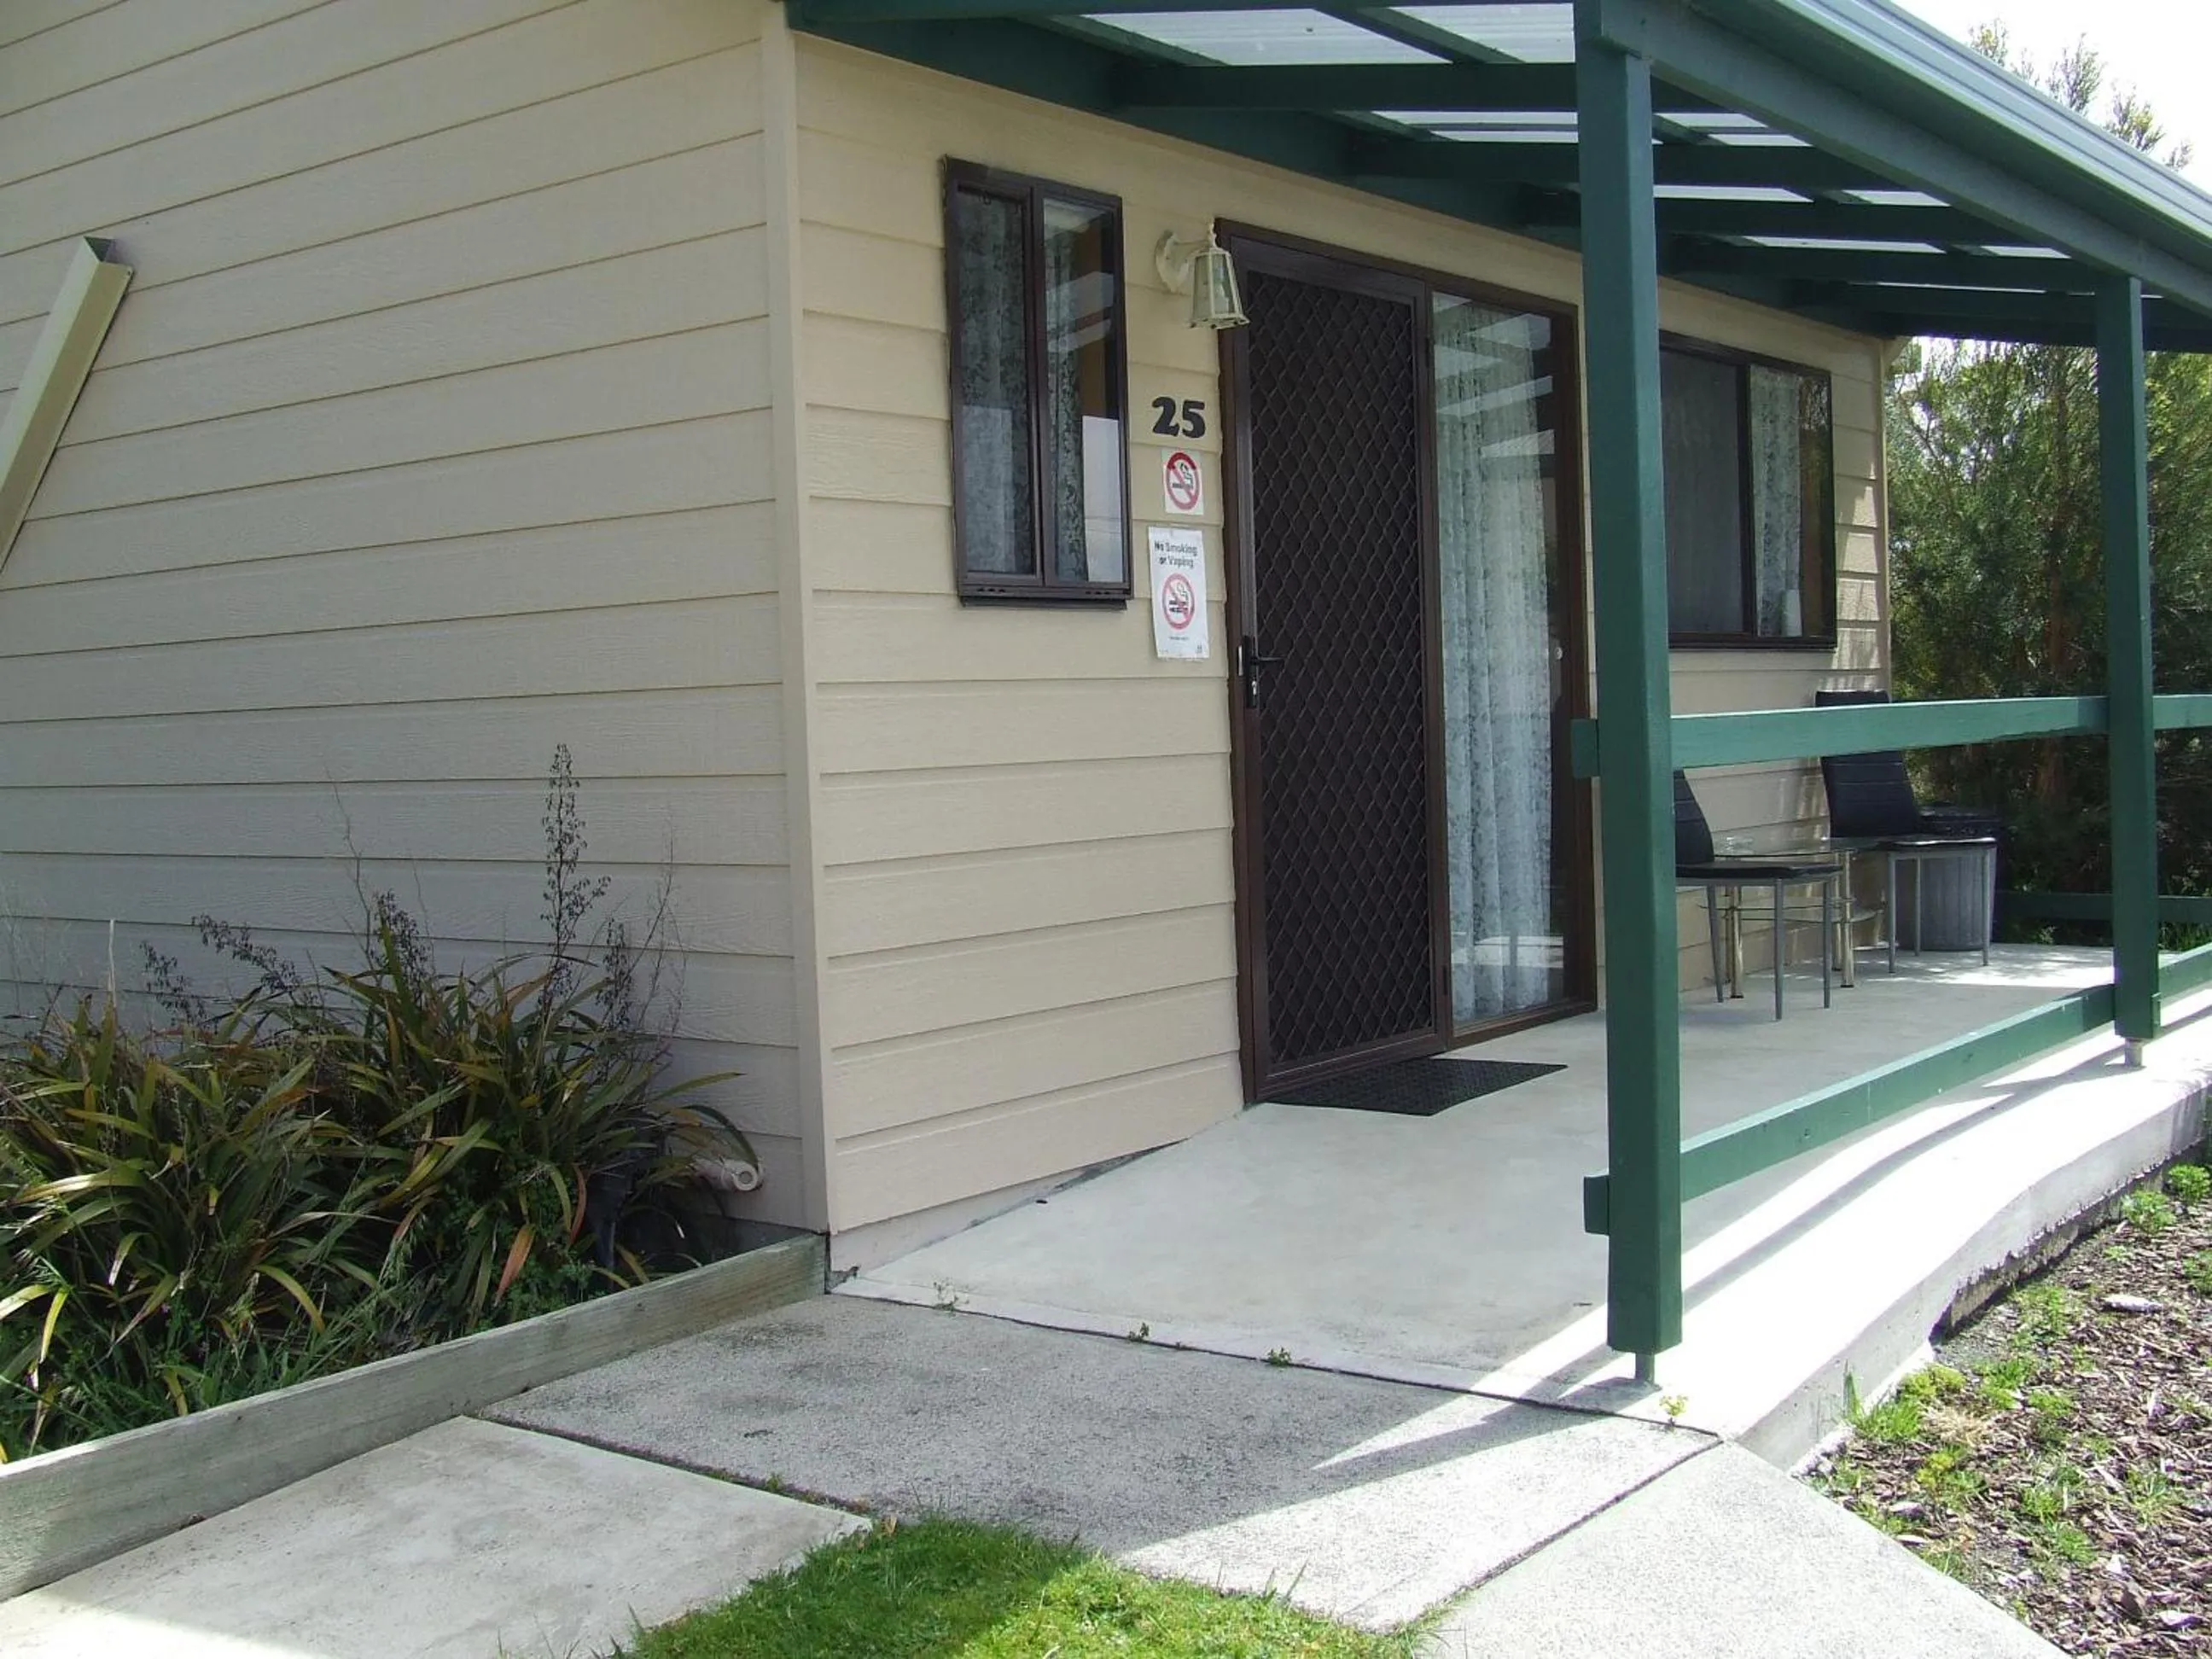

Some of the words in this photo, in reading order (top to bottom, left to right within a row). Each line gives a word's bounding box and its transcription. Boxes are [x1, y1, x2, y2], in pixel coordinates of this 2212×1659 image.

[1152, 396, 1206, 439] 25
[1155, 541, 1164, 551] No
[1165, 542, 1197, 556] Smoking
[1160, 556, 1167, 565] or
[1168, 556, 1194, 568] Vaping
